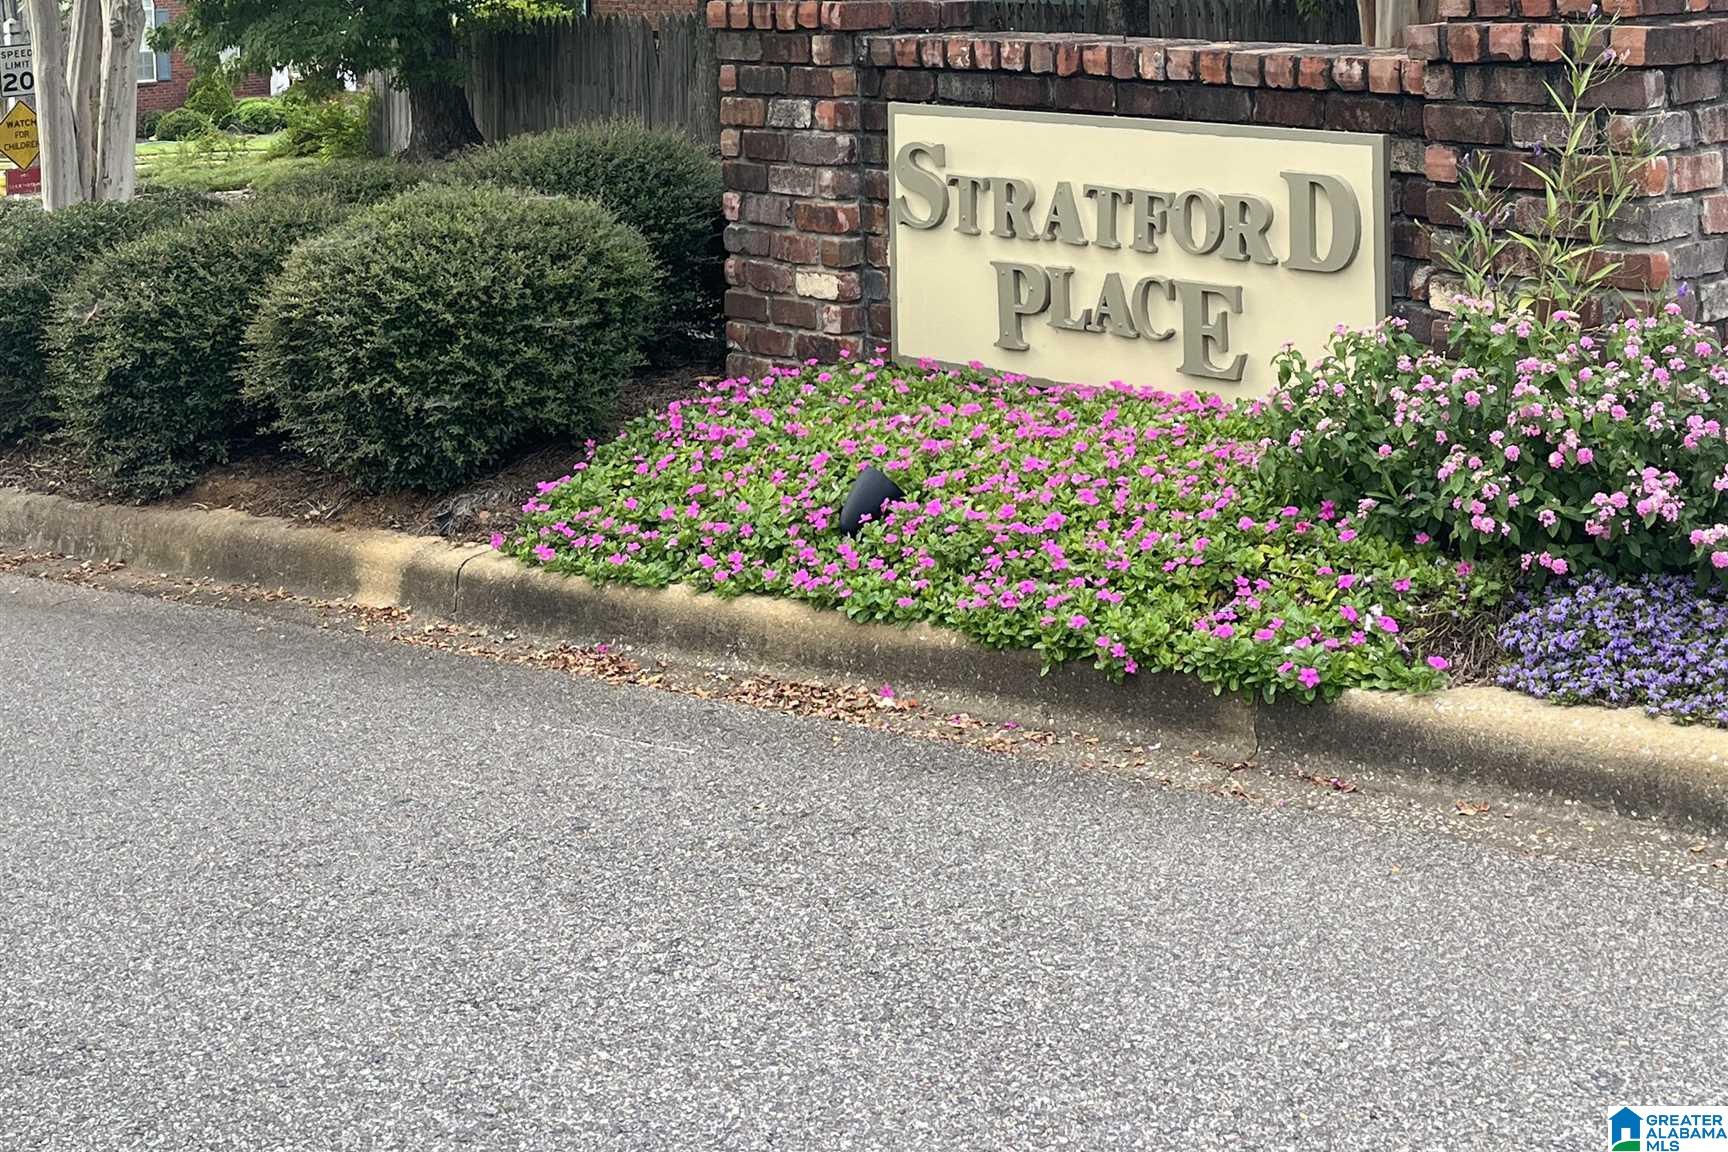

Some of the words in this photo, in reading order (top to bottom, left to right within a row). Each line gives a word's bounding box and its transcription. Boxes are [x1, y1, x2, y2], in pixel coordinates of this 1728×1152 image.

[1, 49, 32, 59] SPEED
[5, 61, 29, 70] LIMIT
[3, 72, 34, 92] 20
[6, 119, 37, 128] WATCH
[15, 131, 29, 139] FOR
[895, 141, 1361, 273] STRATFORD
[989, 260, 1249, 382] PLACE
